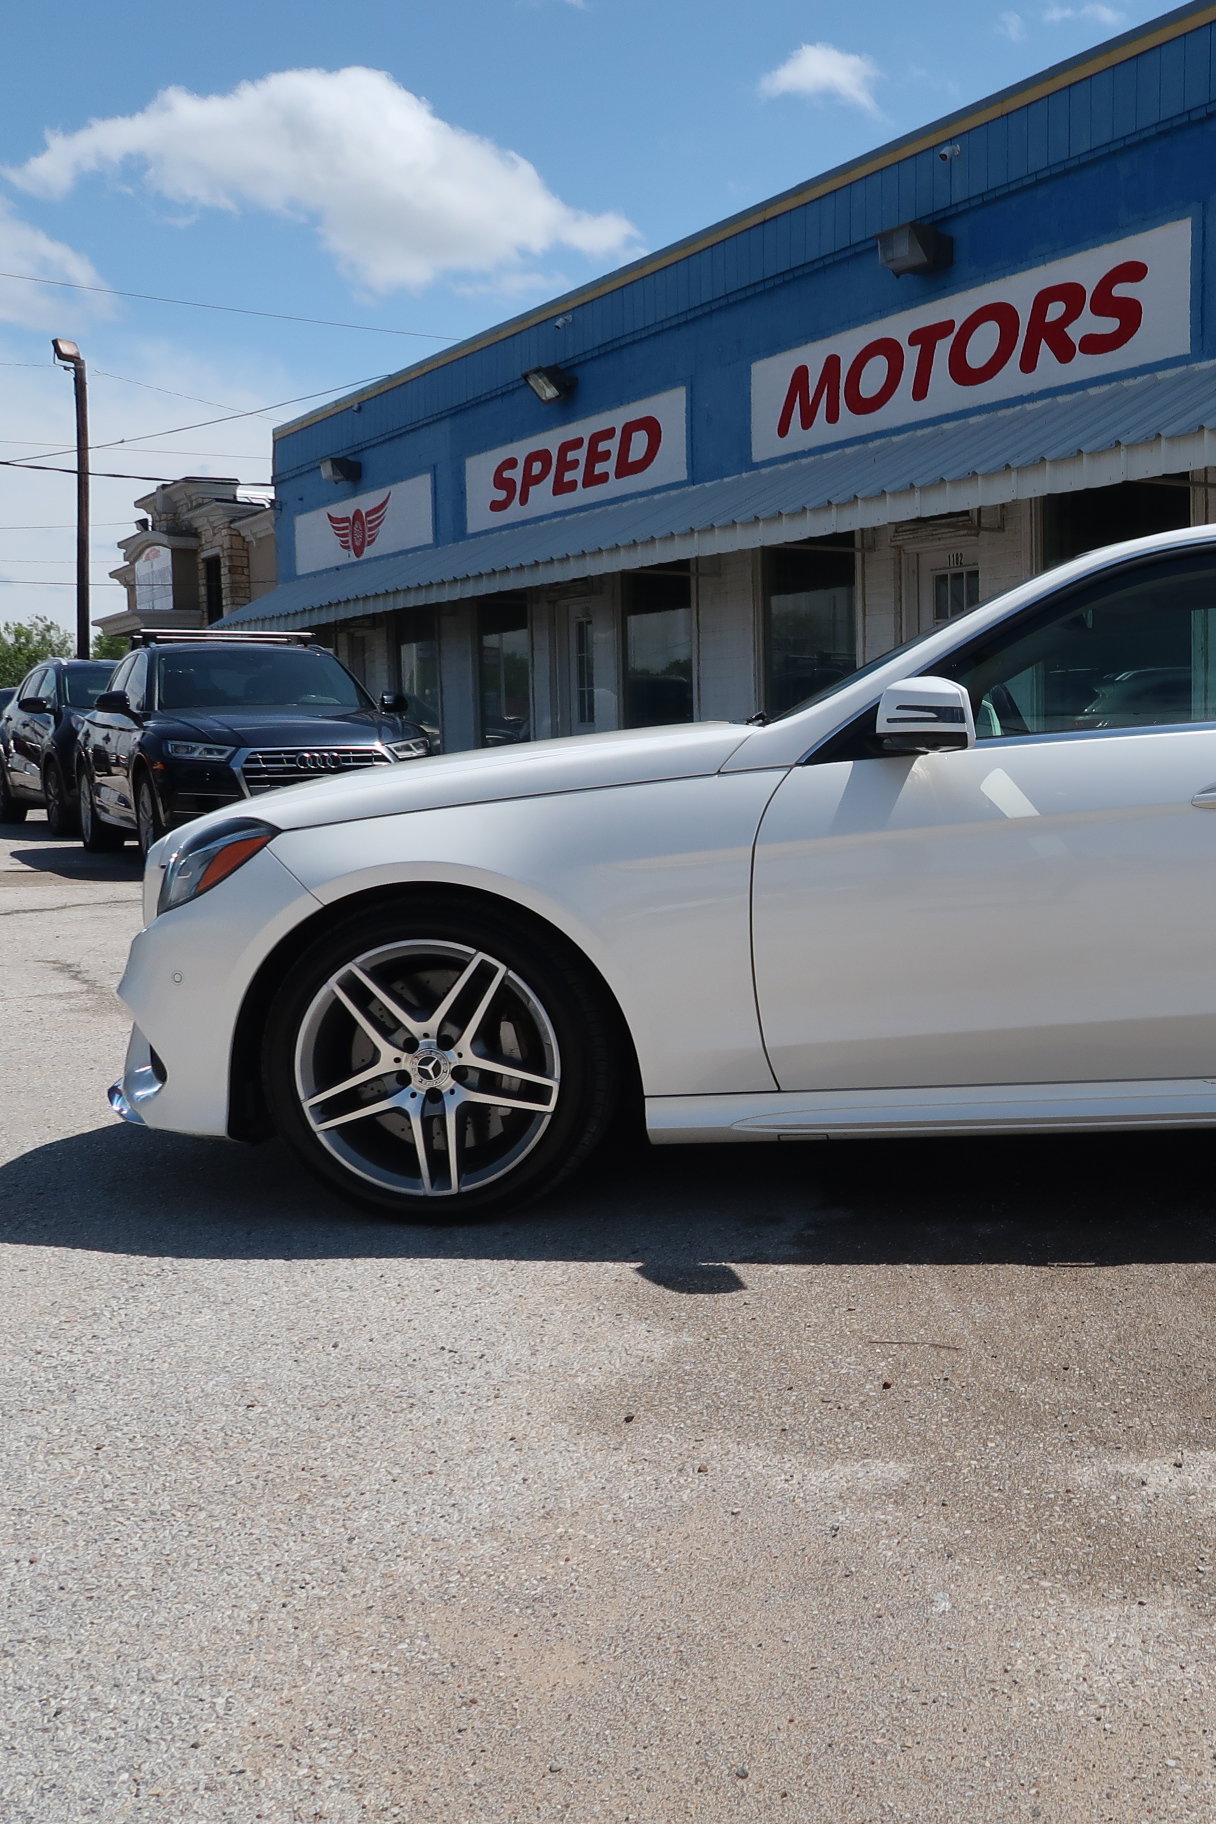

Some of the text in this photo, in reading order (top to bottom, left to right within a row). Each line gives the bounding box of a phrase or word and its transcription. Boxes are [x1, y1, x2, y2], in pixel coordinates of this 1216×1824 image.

[490, 260, 1148, 511] SPEED MOTORS
[948, 552, 964, 567] 1102
